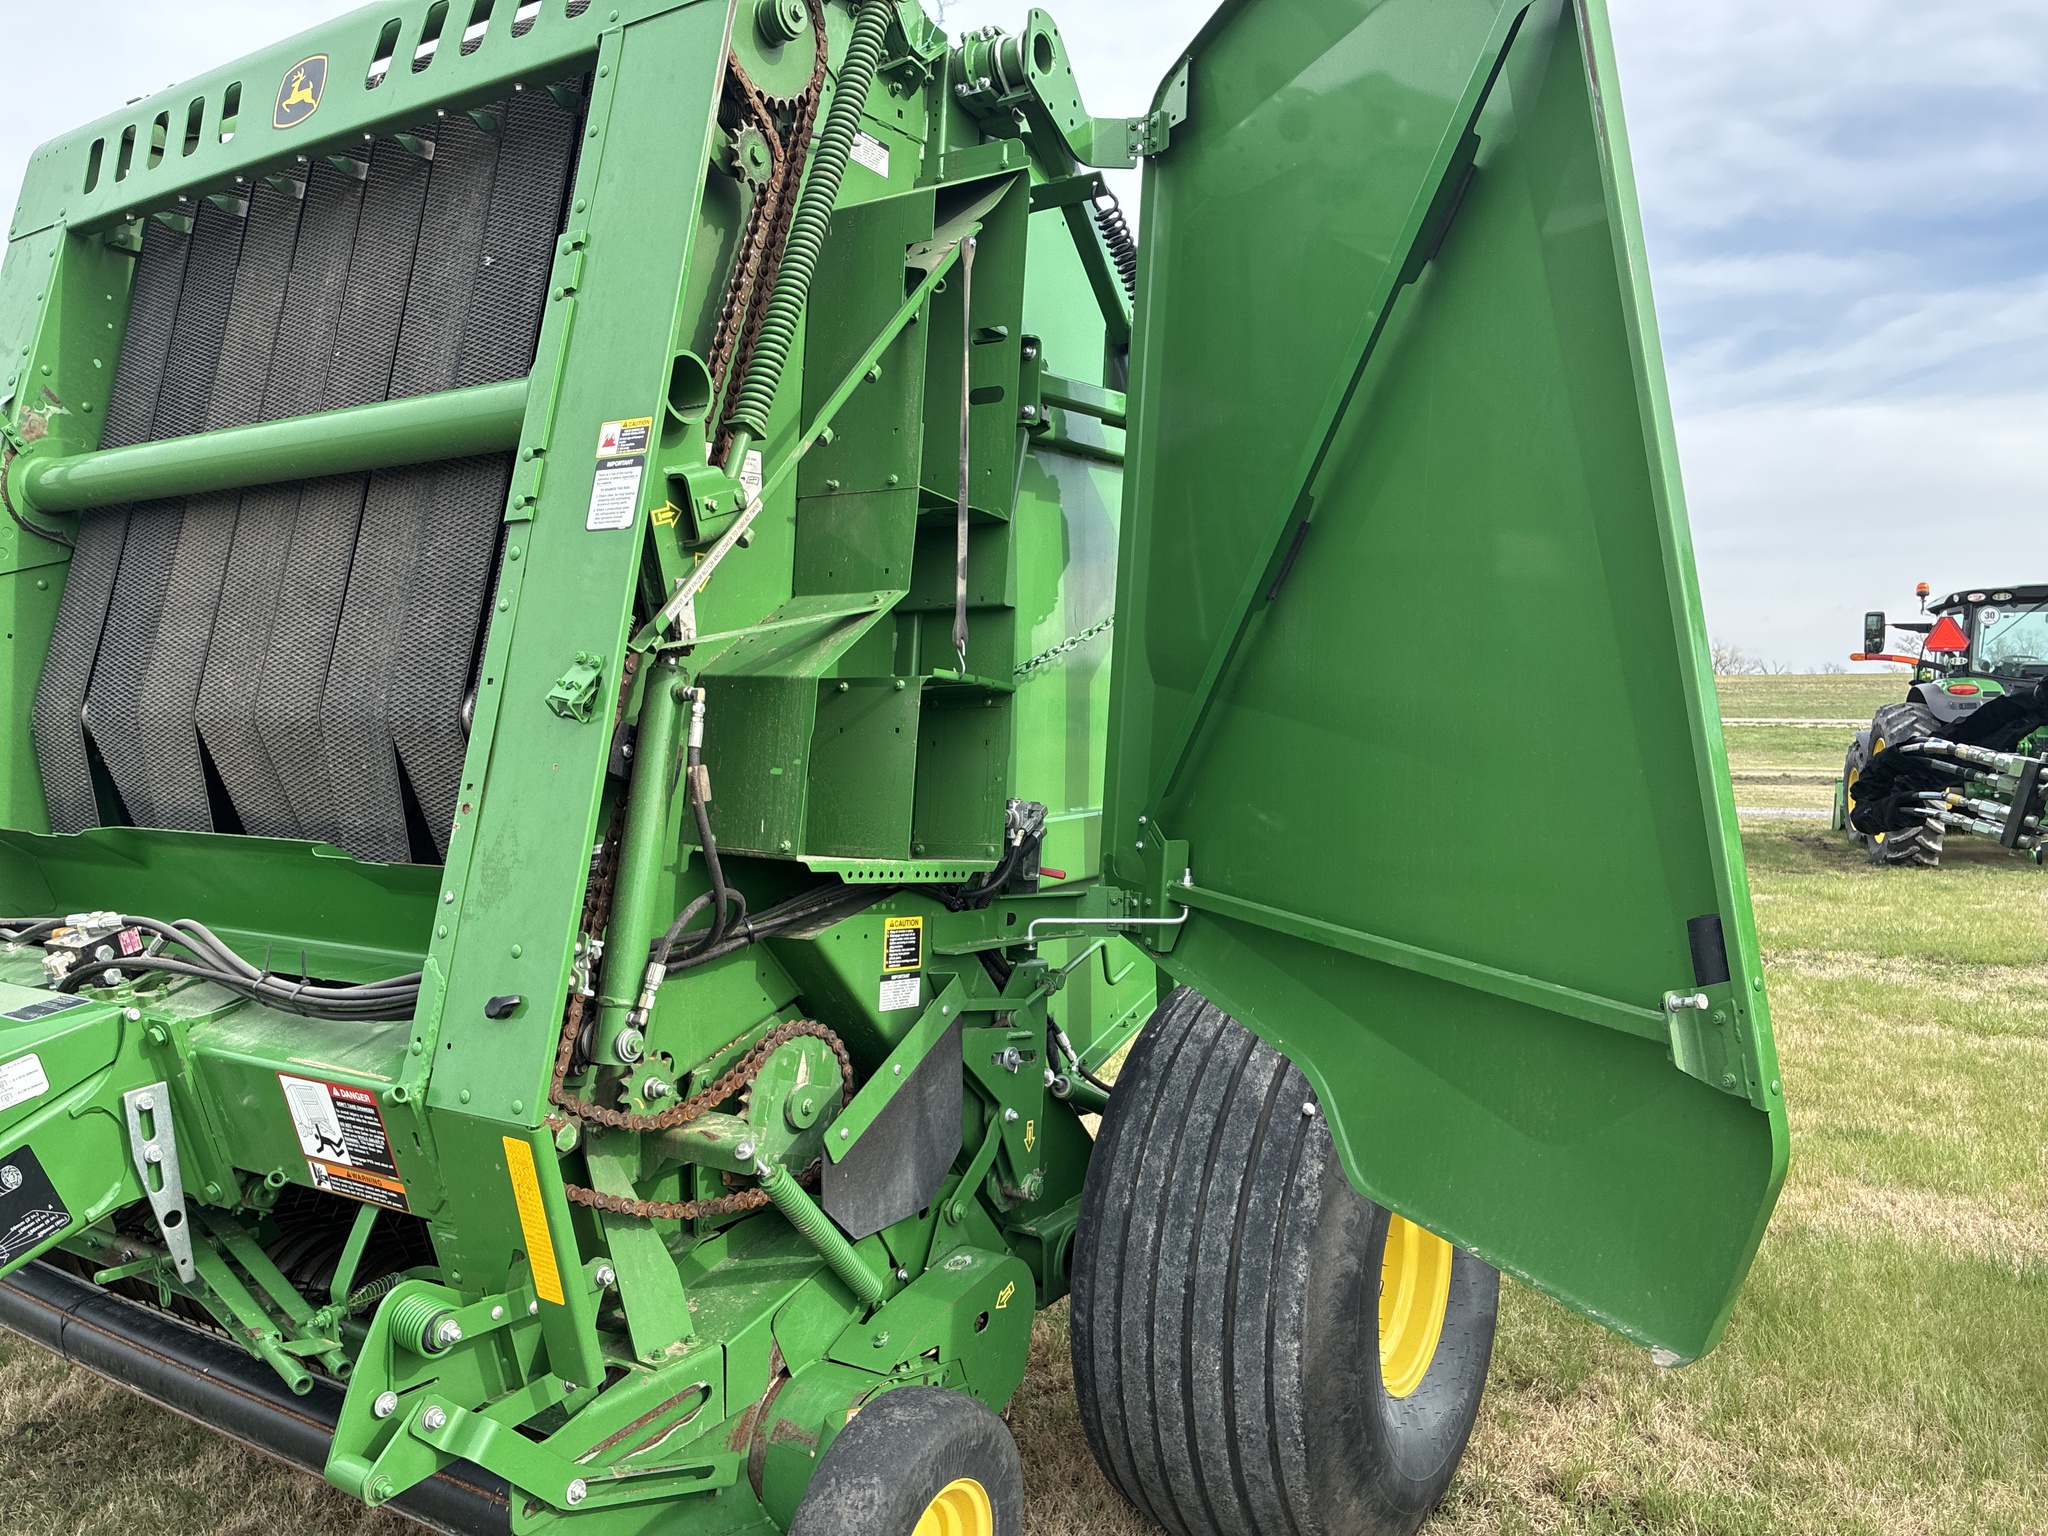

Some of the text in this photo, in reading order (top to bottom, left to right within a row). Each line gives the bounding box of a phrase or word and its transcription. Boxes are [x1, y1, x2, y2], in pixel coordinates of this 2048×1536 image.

[607, 459, 634, 467] IMPORTANT
[669, 501, 761, 617] REMOVE ARM FROM NOTCH AND LOWER TO THREAD TWINE
[895, 919, 919, 927] CAUTION
[340, 1089, 371, 1103] DANGER
[352, 1173, 383, 1186] WARNING
